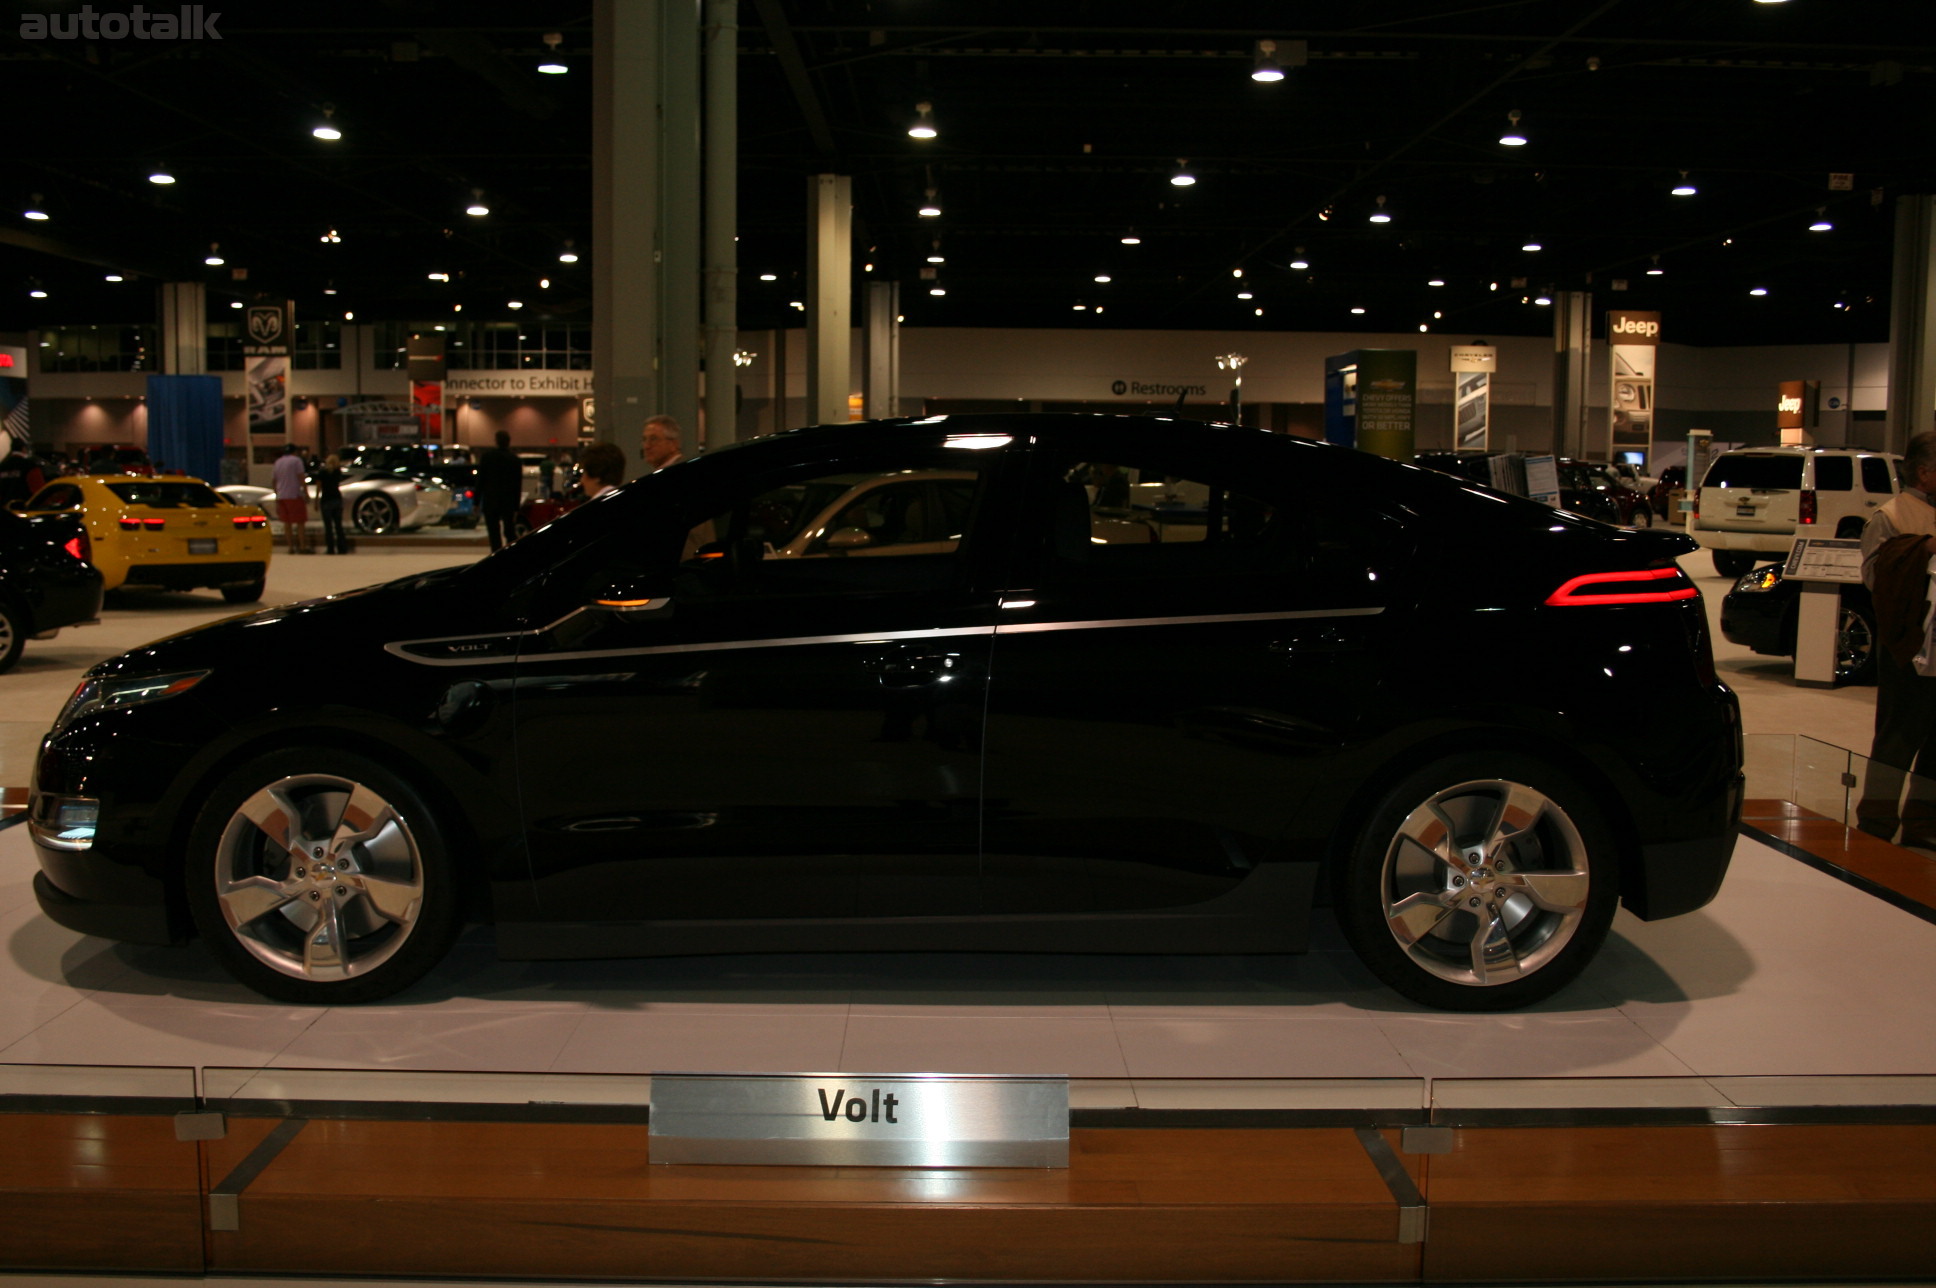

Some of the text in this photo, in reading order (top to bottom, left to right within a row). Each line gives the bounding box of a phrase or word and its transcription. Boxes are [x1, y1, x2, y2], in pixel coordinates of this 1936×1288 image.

[1612, 316, 1659, 337] Jeep
[243, 345, 287, 354] RAM
[510, 378, 525, 390] to
[529, 376, 579, 390] Exhibit
[1131, 381, 1206, 396] Restrooms
[1778, 394, 1802, 414] Jeep
[1362, 421, 1411, 430] OR BETTER
[448, 643, 492, 652] VOLT
[818, 1088, 899, 1123] Volt
